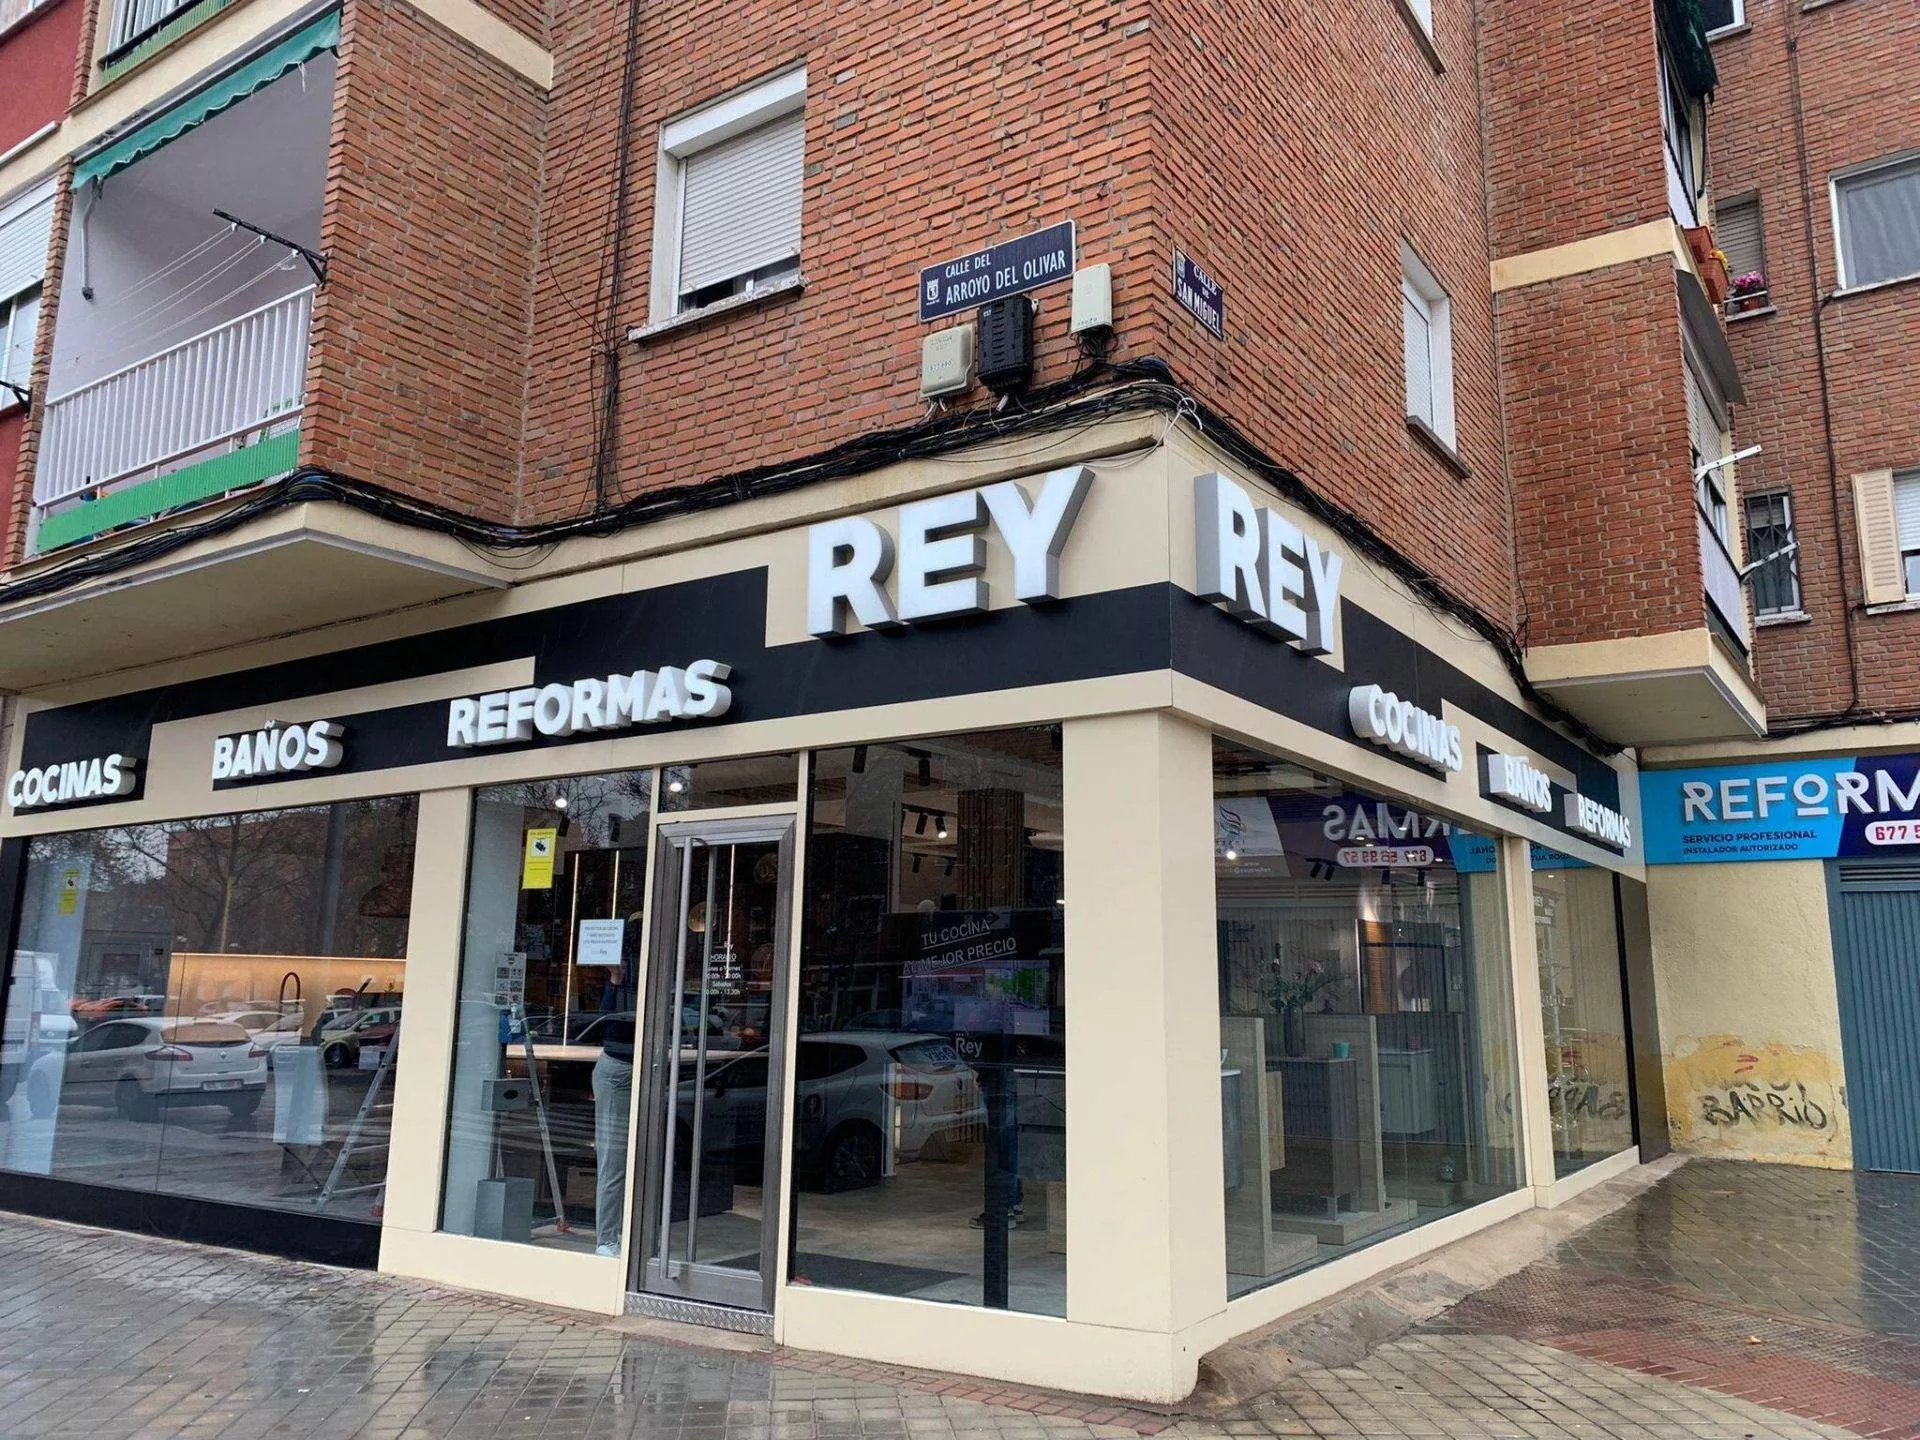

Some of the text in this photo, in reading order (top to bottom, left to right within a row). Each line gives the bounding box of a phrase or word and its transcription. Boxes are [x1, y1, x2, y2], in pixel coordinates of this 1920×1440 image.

[945, 253, 992, 279] CALLE DEL
[945, 249, 1066, 306] ARROYO DEL OLIVAR
[1193, 265, 1218, 296] CALLE
[1177, 278, 1221, 334] SAN MIGUEL
[807, 465, 1095, 639] REY
[1194, 472, 1343, 656] REY
[447, 659, 732, 748] REFORMAS
[1349, 684, 1463, 772] COCINAS
[213, 720, 344, 780] BAÑOS
[7, 754, 136, 808] COCINAS
[1564, 793, 1632, 847] REFORMAS
[1682, 829, 1818, 845] SERVICIO PROFESIONAL
[1875, 825, 1908, 841] 677
[1683, 843, 1799, 855] INSTALADOR AUTORIZADO
[919, 950, 965, 971] MEJOR
[967, 936, 1017, 961] PRECIO
[920, 918, 991, 946] TU COCINA
[955, 1037, 983, 1058] Rey
